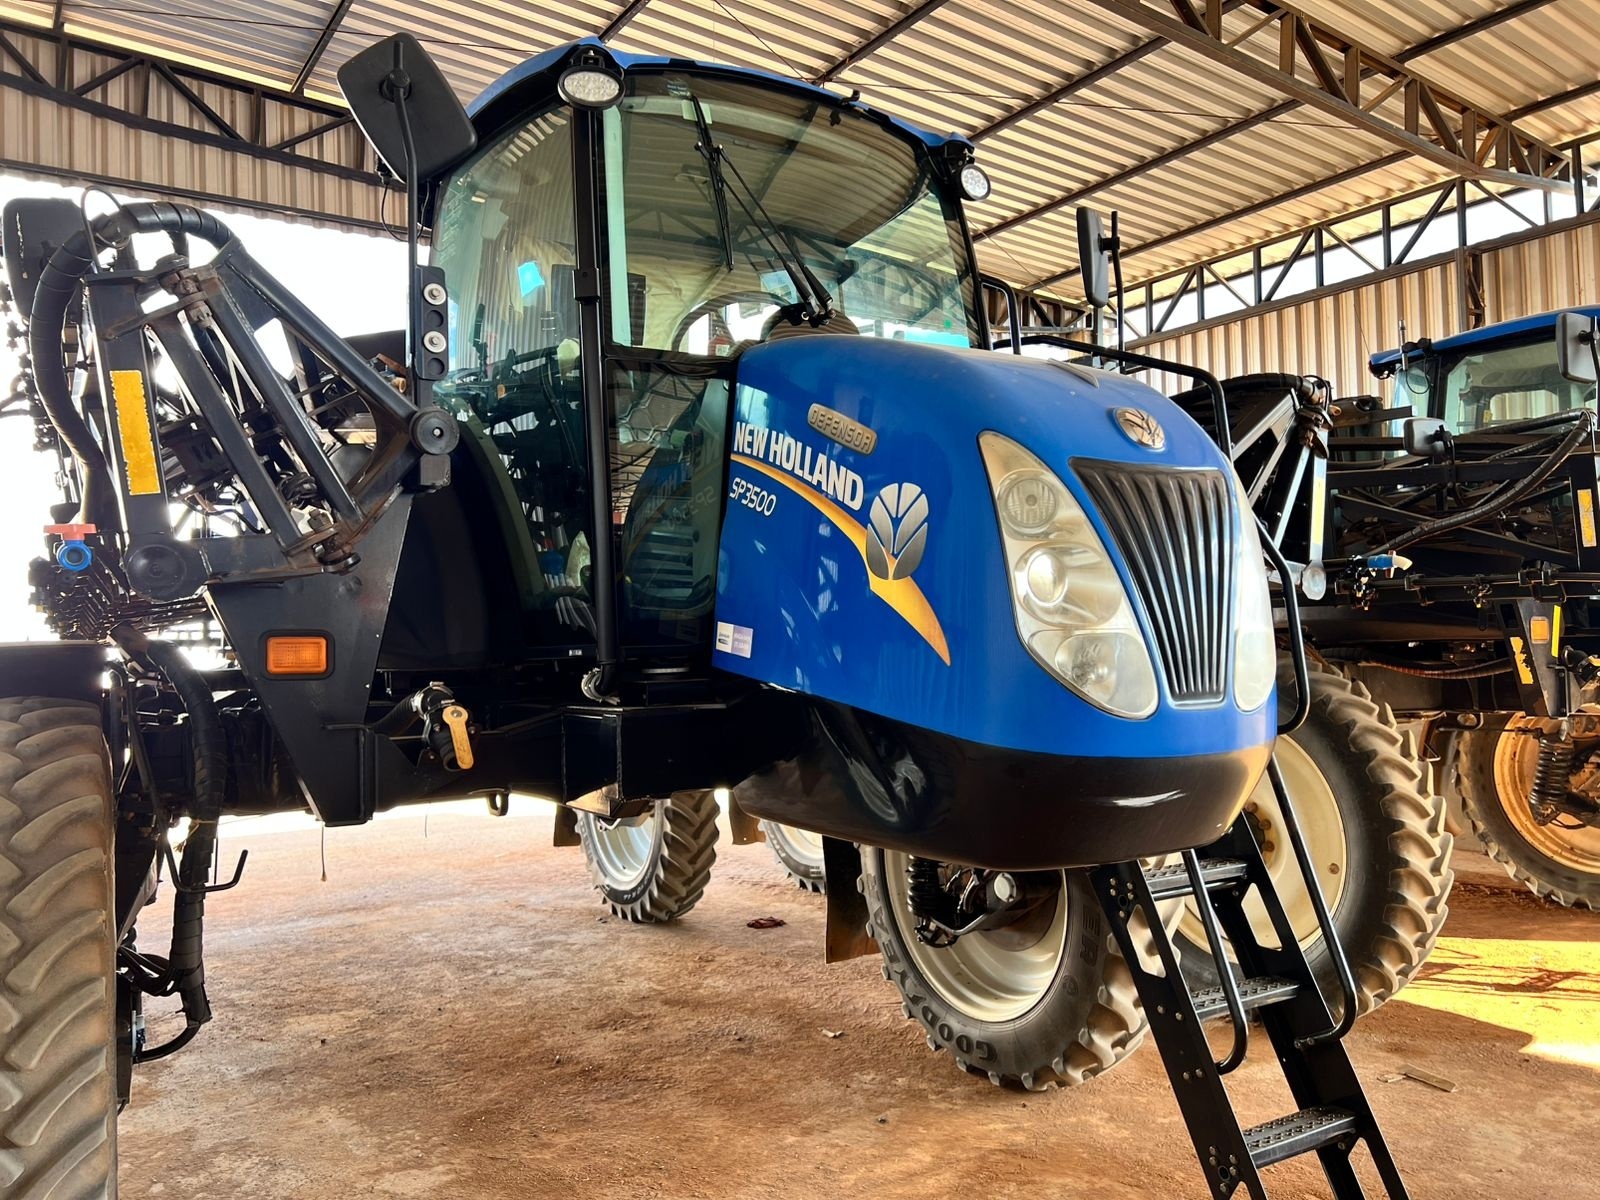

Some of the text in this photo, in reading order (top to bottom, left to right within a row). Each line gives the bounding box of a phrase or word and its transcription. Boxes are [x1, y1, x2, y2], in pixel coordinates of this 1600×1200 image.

[809, 404, 871, 452] DEFENSOR
[733, 421, 770, 459] NEW
[769, 430, 864, 511] HOLLAND
[729, 477, 777, 517] SP3500
